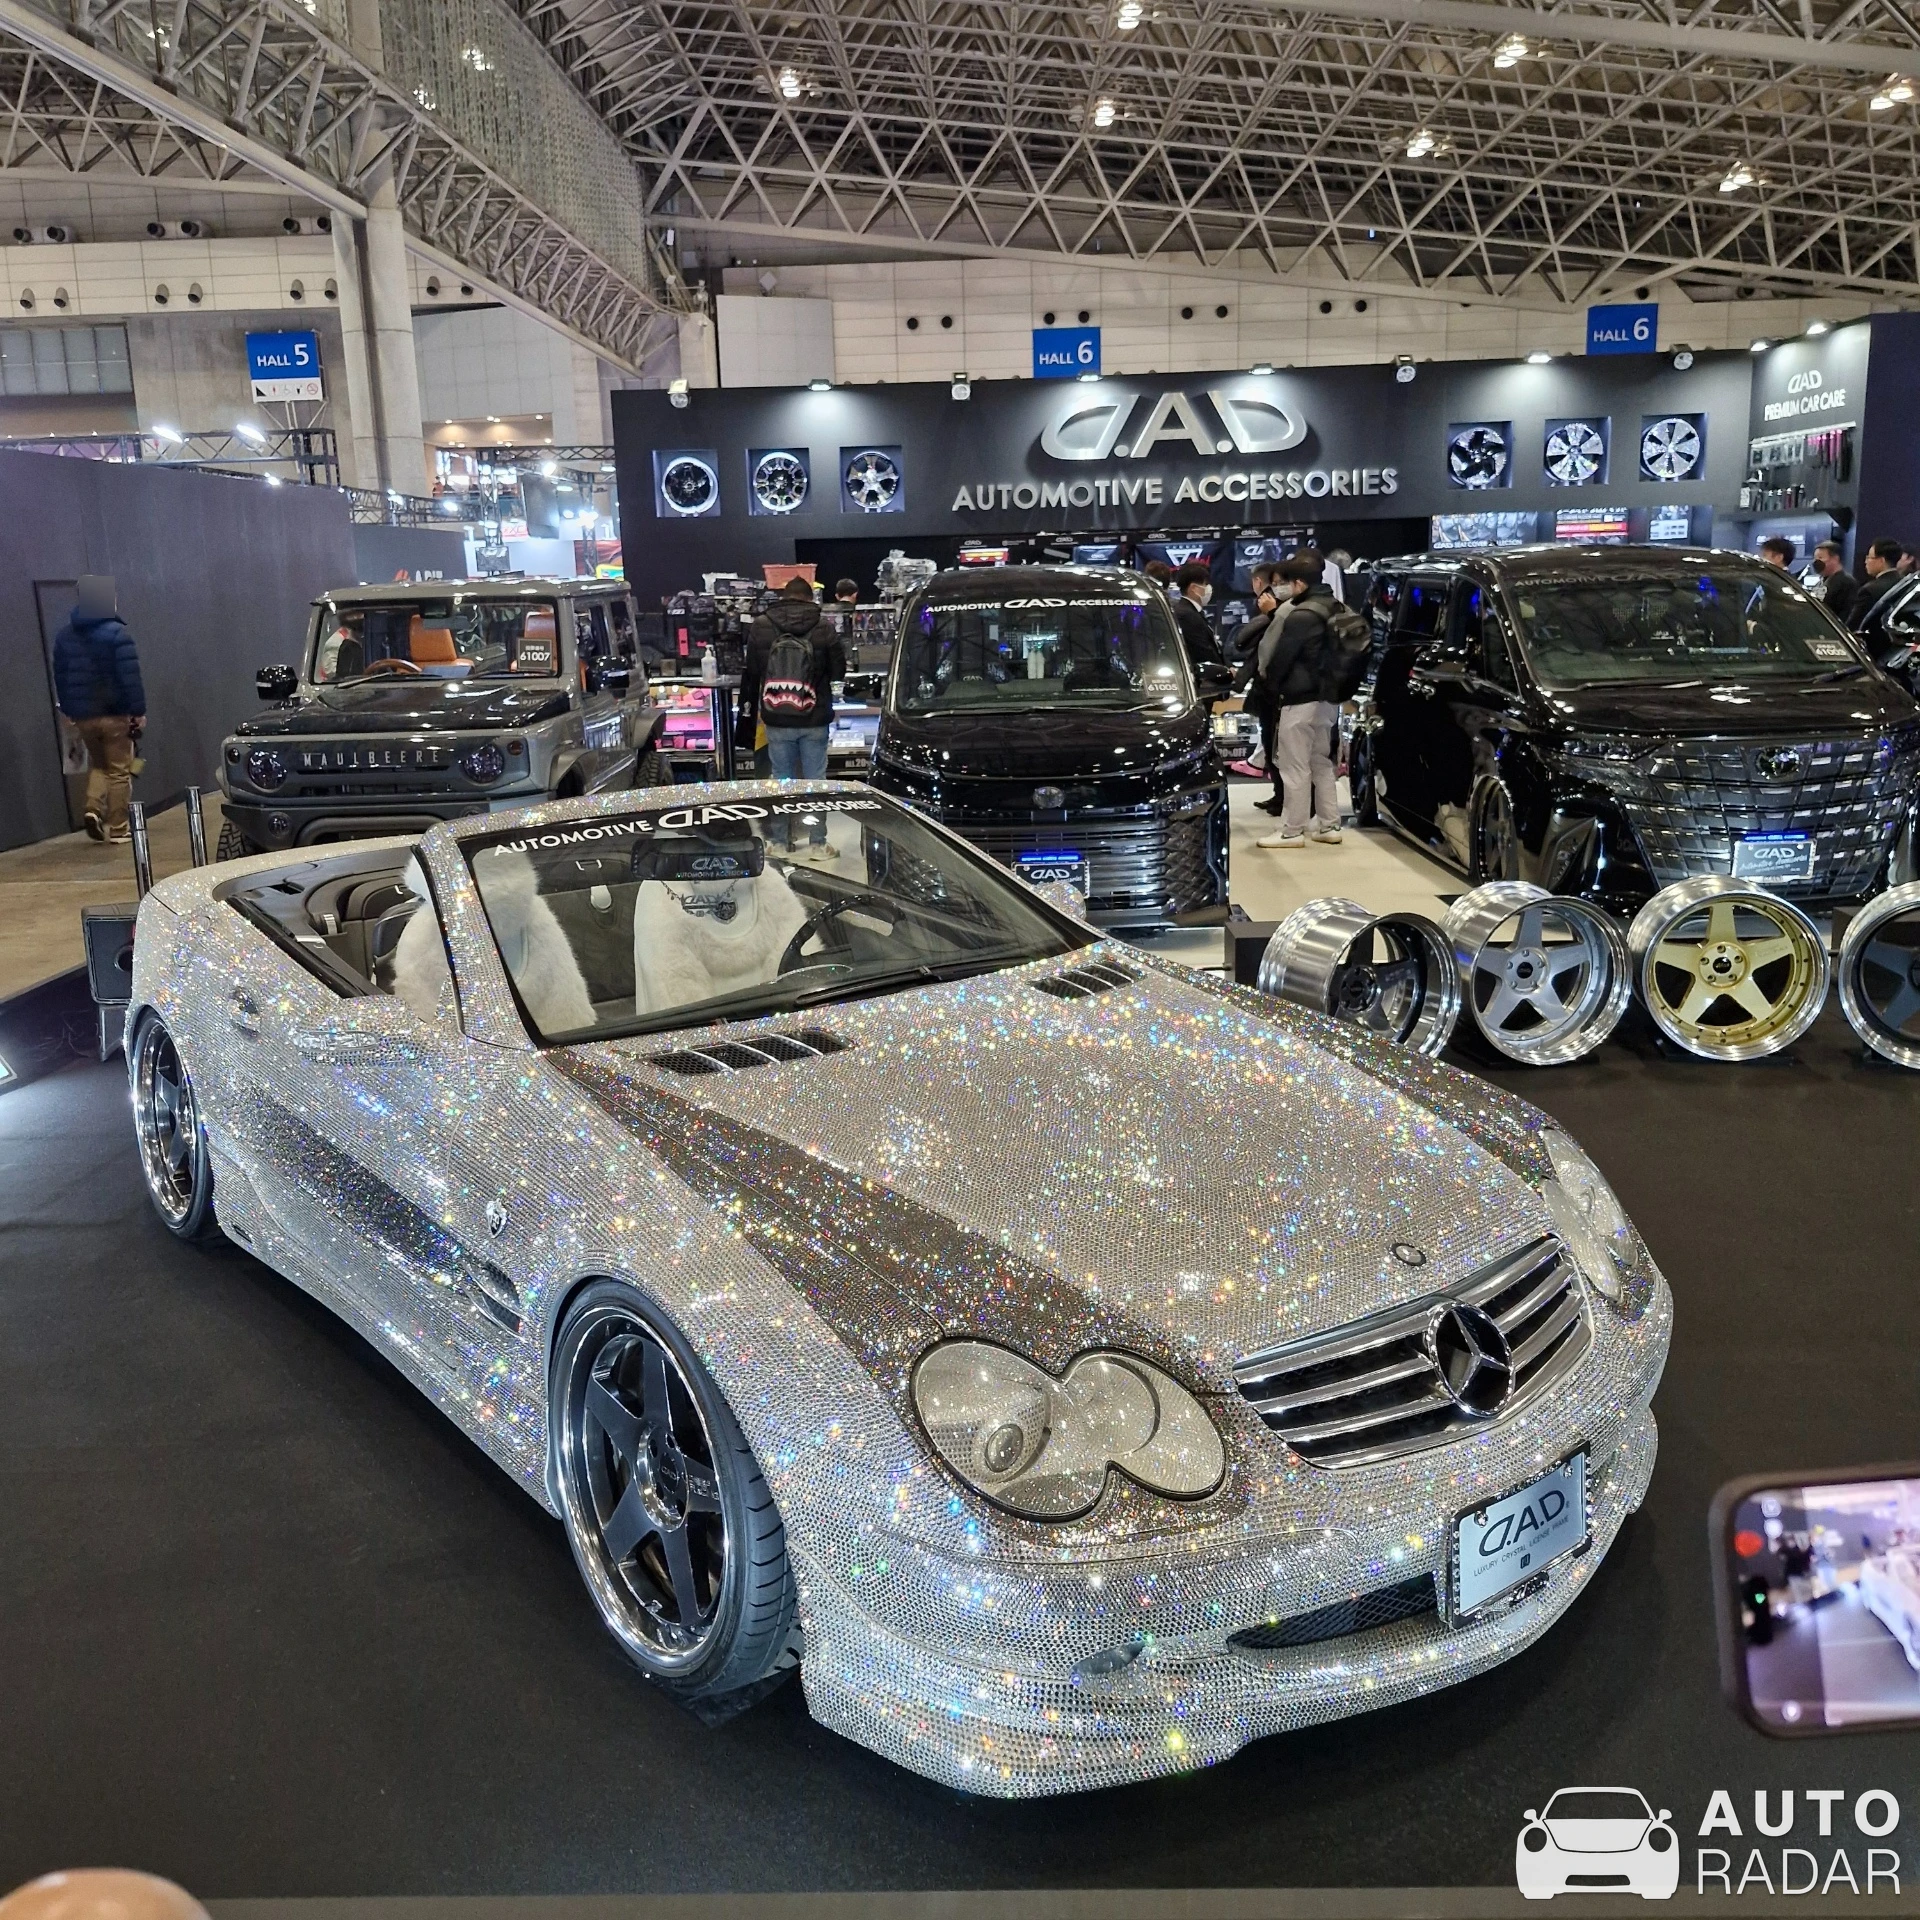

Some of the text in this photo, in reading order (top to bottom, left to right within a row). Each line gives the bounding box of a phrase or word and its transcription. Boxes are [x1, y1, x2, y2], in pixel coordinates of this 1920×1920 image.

[1593, 317, 1649, 342] HALL 6
[256, 343, 309, 367] HALL 5
[1039, 340, 1094, 365] HALL 6
[1764, 388, 1847, 422] PREMIUM CAR CARE
[951, 467, 1399, 512] AUTOMOTIVE ACCESSORIES
[1515, 575, 1605, 587] AUTOMOTIVE
[925, 602, 1001, 613] AUTOMOTIVE
[520, 651, 551, 661] 61007
[1148, 683, 1178, 692] 61005
[303, 750, 439, 767] MAULBEERE
[494, 819, 653, 857] AUTOMOTIVE
[772, 800, 882, 815] ACCESSORIES
[1473, 1558, 1499, 1577] LUXURY
[1501, 1543, 1527, 1563] CRYSTAL
[1529, 1527, 1550, 1547] LICENSE
[1552, 1514, 1569, 1530] FRAME
